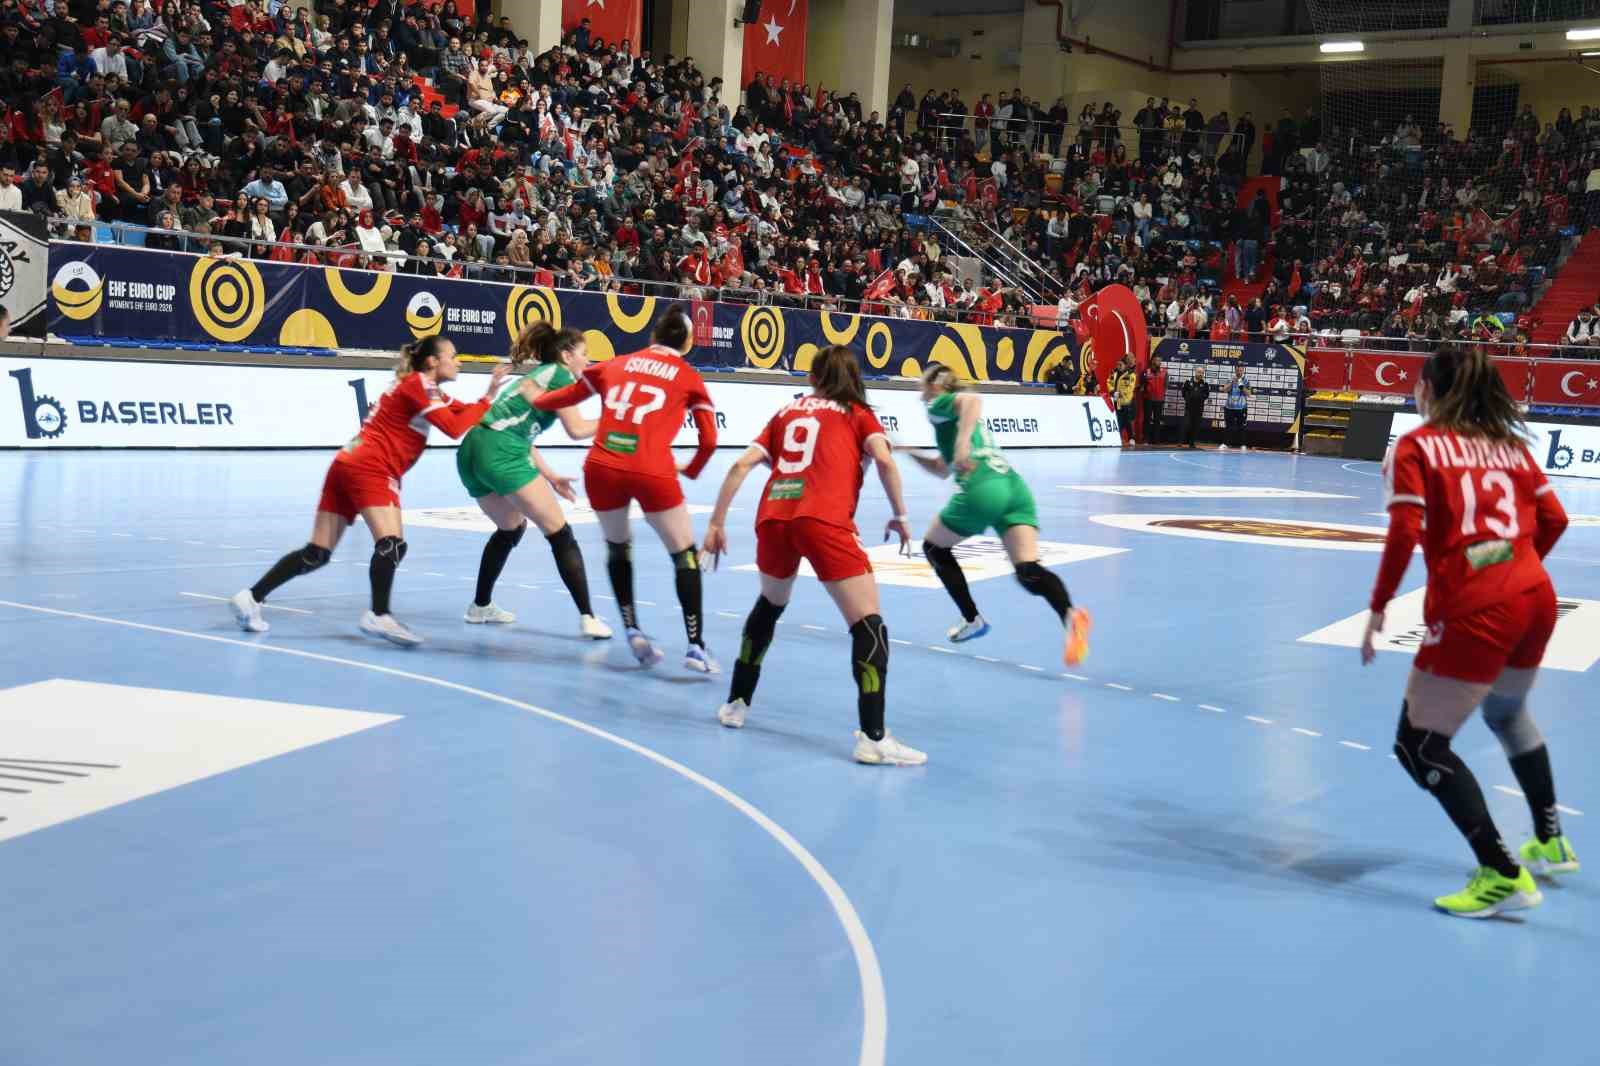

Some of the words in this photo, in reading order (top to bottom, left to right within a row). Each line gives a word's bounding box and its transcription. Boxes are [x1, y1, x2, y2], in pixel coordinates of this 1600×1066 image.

[109, 280, 127, 297] EHF
[128, 282, 154, 299] EURO
[156, 284, 176, 301] CUP
[448, 307, 461, 322] EHF
[462, 309, 480, 323] EURO
[481, 310, 496, 324] CUP
[604, 381, 666, 424] 47
[777, 416, 820, 474] 9
[1460, 469, 1520, 539] 13
